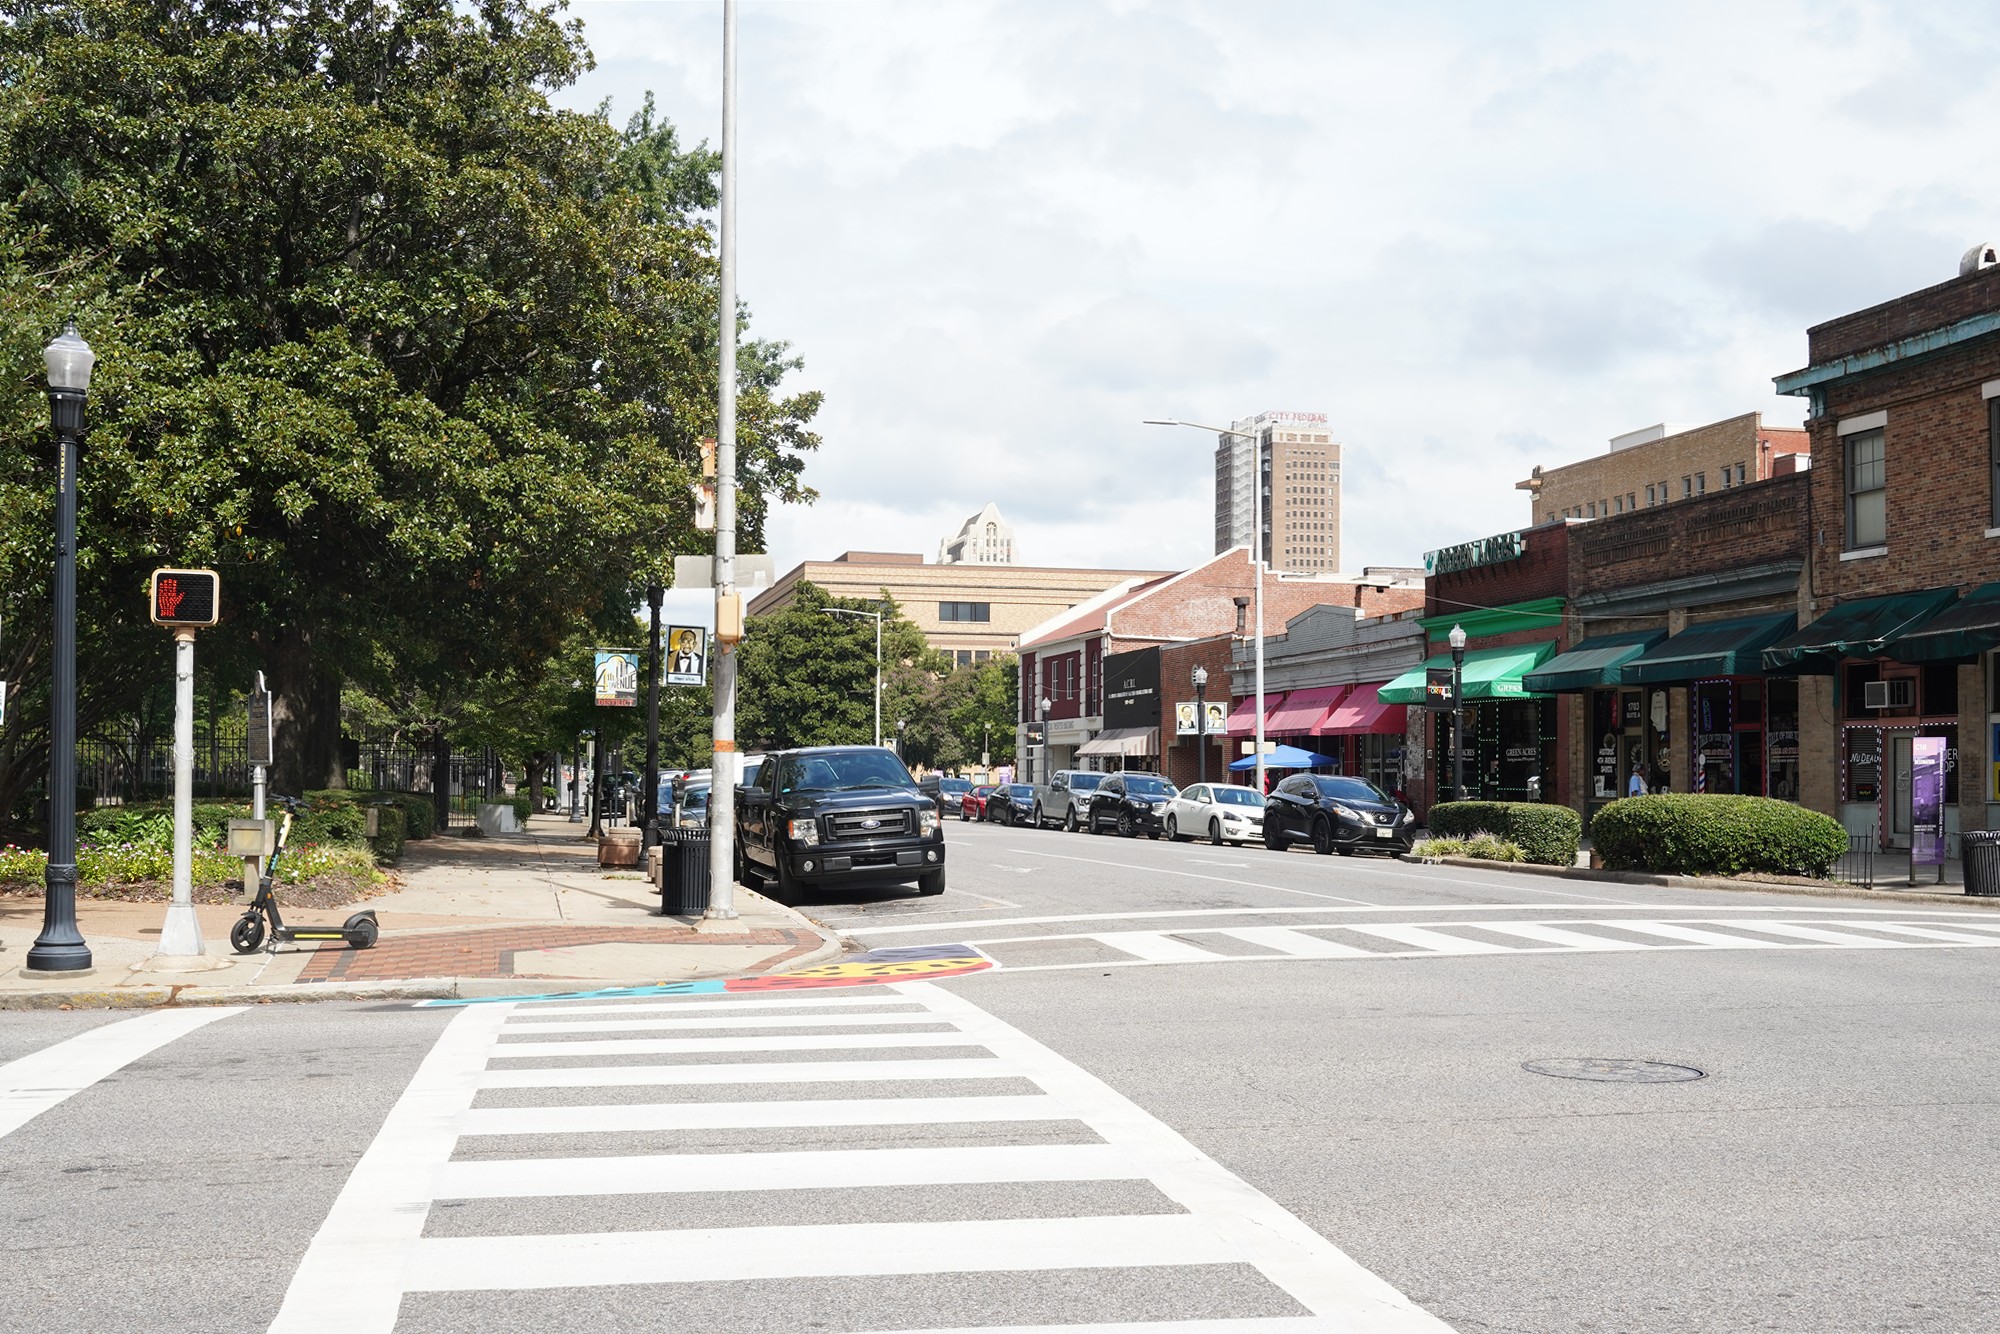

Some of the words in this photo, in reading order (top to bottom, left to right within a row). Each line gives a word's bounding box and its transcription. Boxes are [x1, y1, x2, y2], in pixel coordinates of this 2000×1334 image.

[1269, 412, 1289, 420] CITY
[1293, 413, 1328, 423] FEDERAL
[1506, 748, 1522, 757] GREEN
[1522, 747, 1537, 756] ACRES
